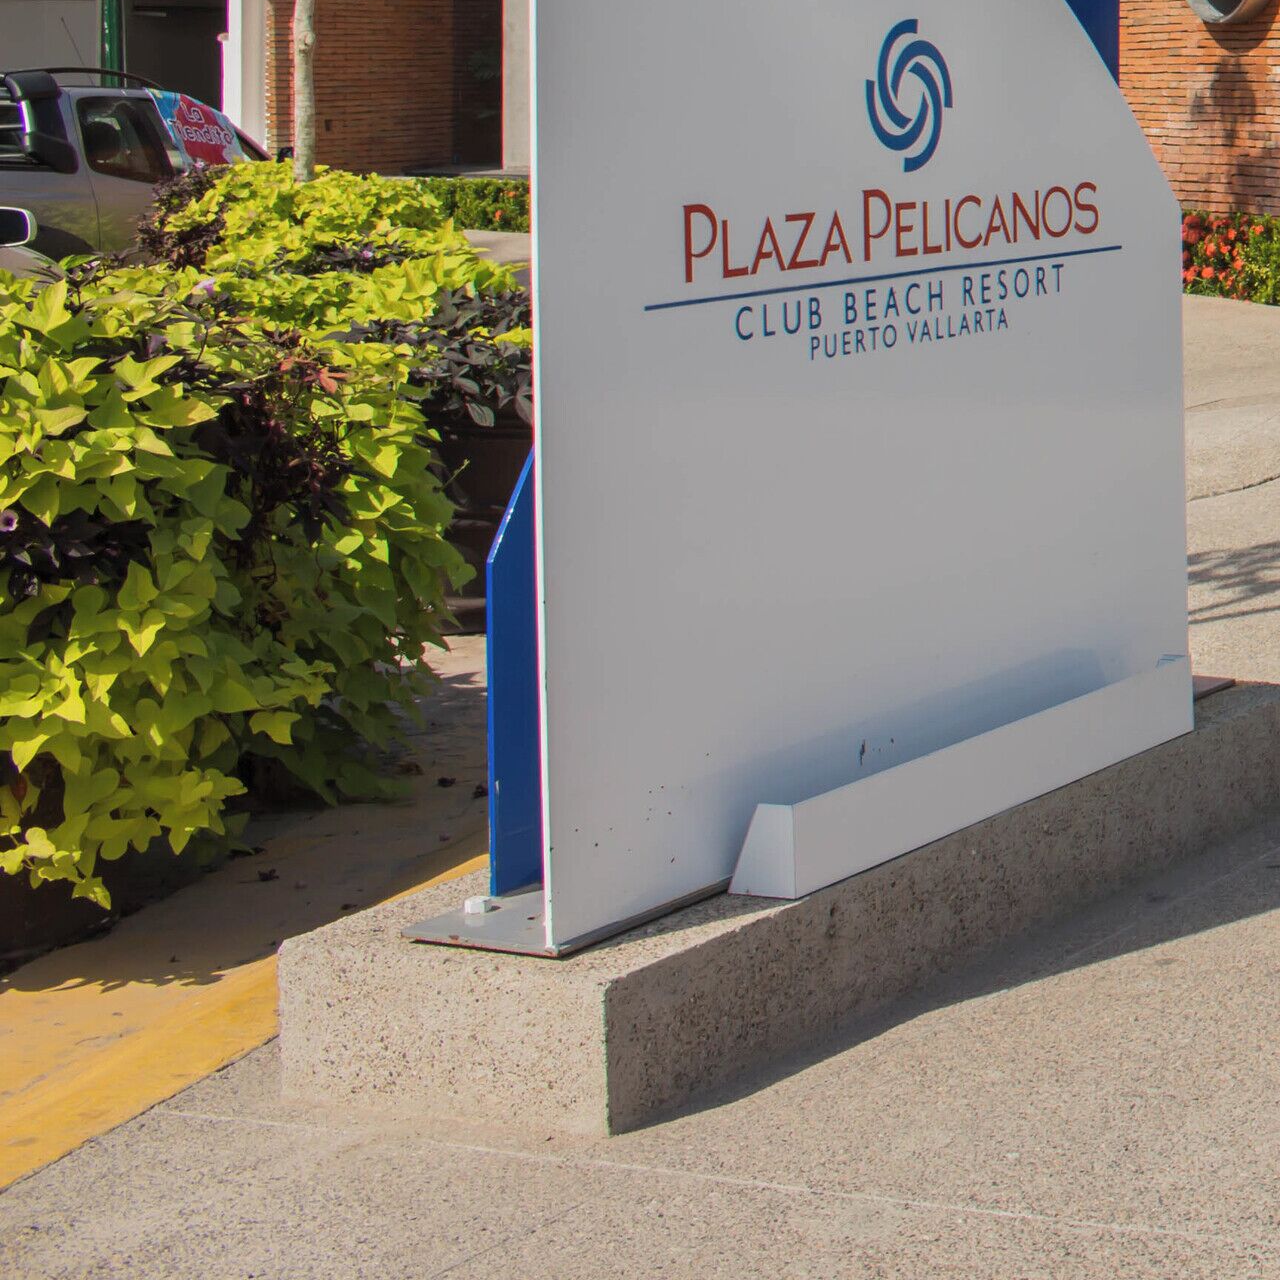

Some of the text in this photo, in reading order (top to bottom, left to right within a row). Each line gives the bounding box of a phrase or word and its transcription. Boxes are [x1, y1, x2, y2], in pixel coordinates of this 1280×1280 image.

[179, 101, 205, 123] La
[683, 181, 1101, 284] PLAZA PELICANOS
[735, 263, 1065, 341] CLUB BEACH RESORT
[809, 307, 1009, 361] PUERTO VALLARTA
